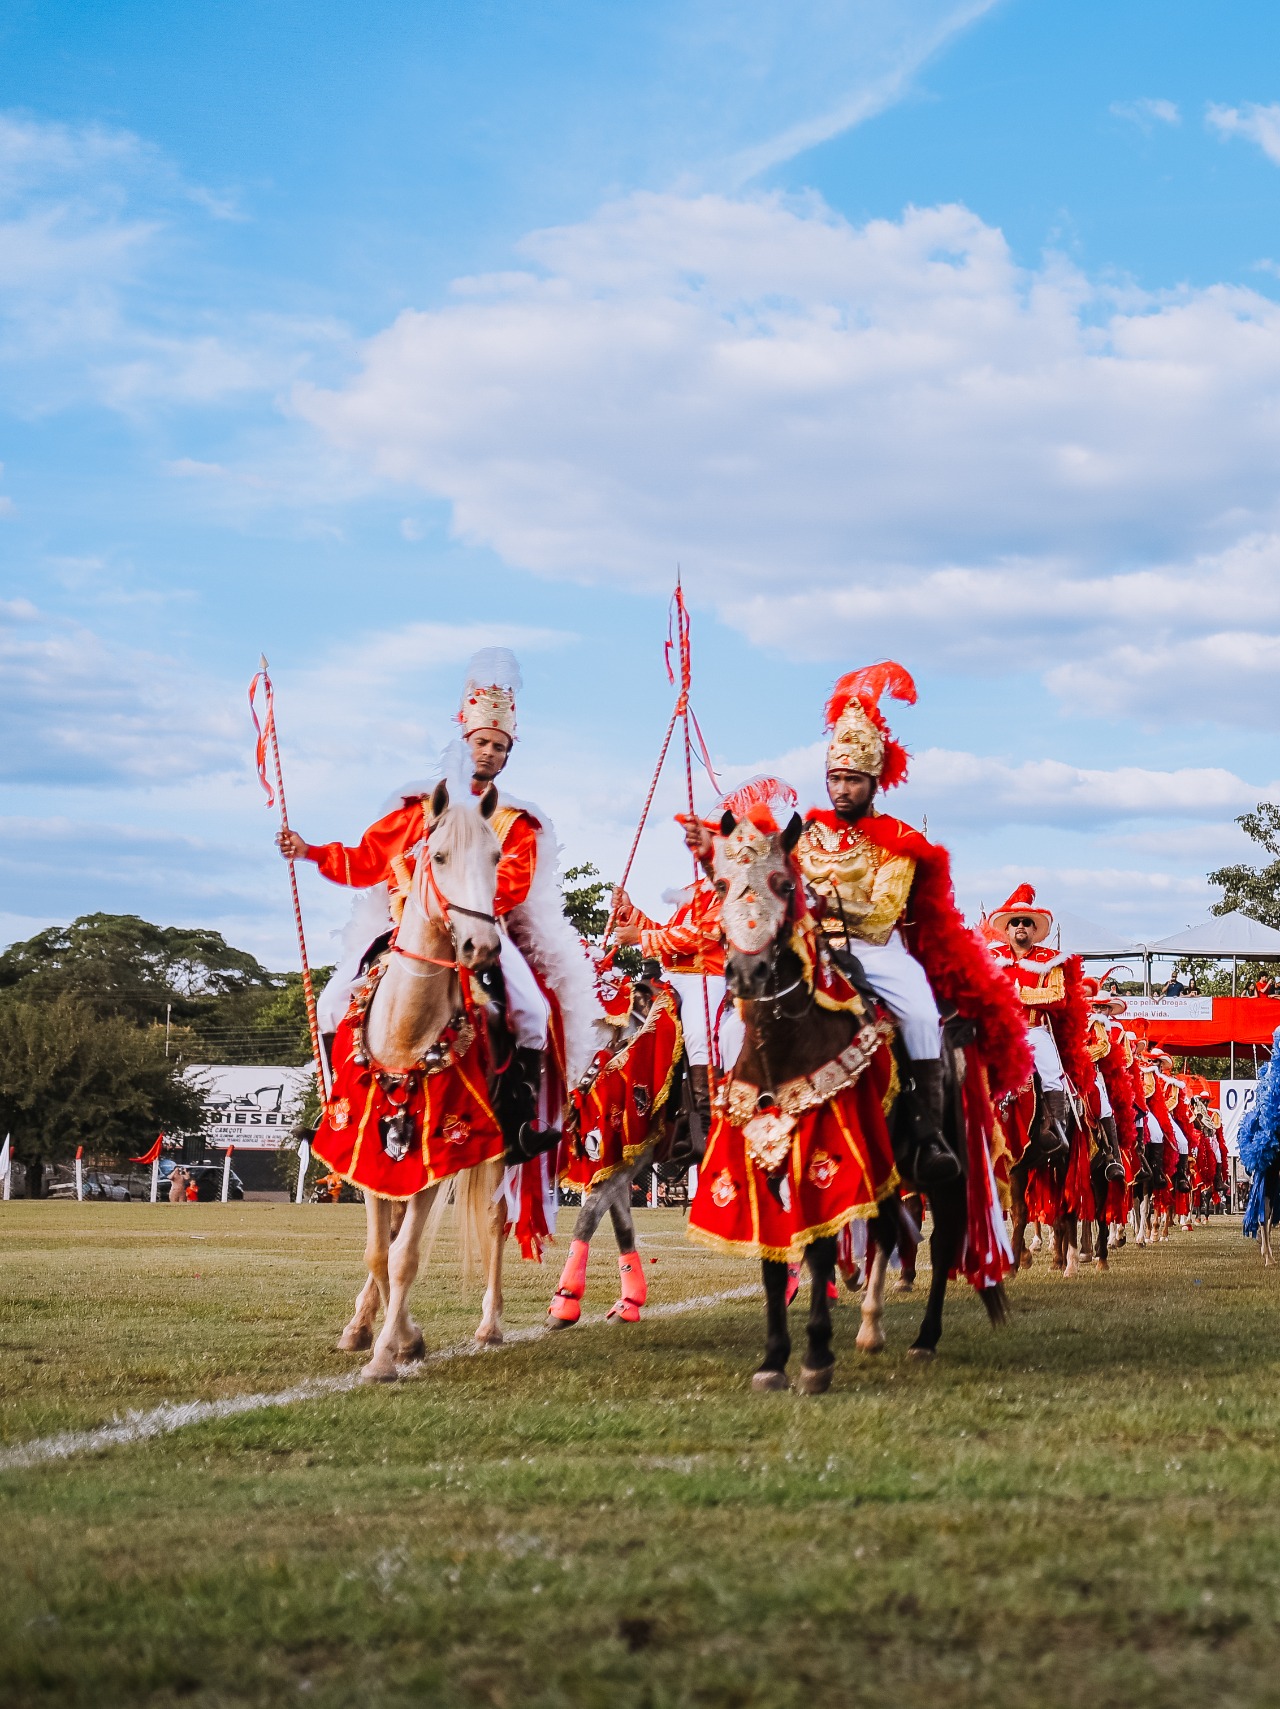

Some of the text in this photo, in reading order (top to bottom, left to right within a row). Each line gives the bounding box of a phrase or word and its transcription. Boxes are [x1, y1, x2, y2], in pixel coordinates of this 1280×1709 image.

[1162, 999, 1188, 1008] Drogas
[1133, 1010, 1149, 1018] pela
[211, 1112, 293, 1125] DIESEL
